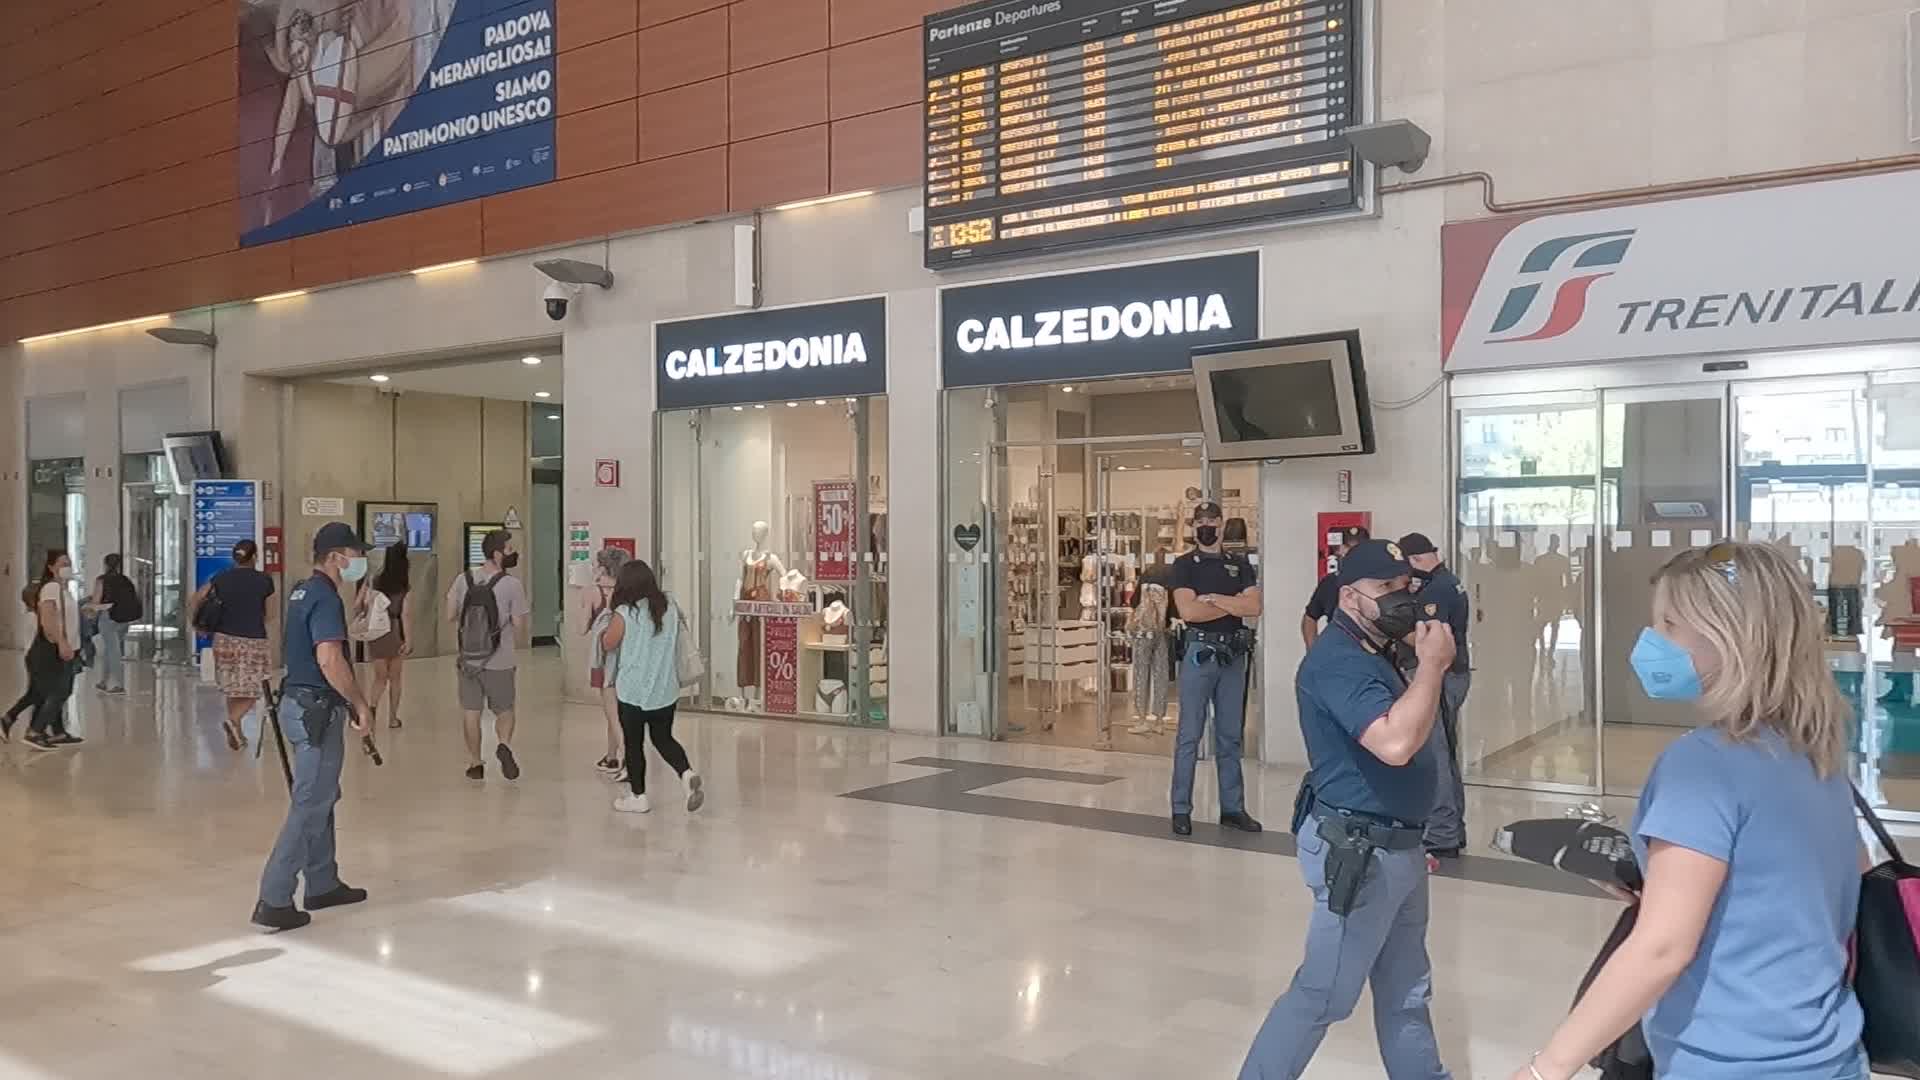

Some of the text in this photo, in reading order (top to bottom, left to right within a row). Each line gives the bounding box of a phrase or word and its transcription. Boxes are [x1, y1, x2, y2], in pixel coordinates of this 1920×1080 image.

[484, 10, 551, 47] PADOVA
[929, 16, 991, 42] Partenze
[995, 0, 1061, 26] Departures
[430, 35, 551, 89] MERAVIGLIOSA!
[495, 70, 551, 102] SIAMO
[383, 97, 551, 156] PATRIMONIO UNESCO
[957, 293, 1232, 353] CALZEDONIA
[1618, 276, 1920, 334] TRENITALI
[665, 332, 867, 380] CALZEDONIA
